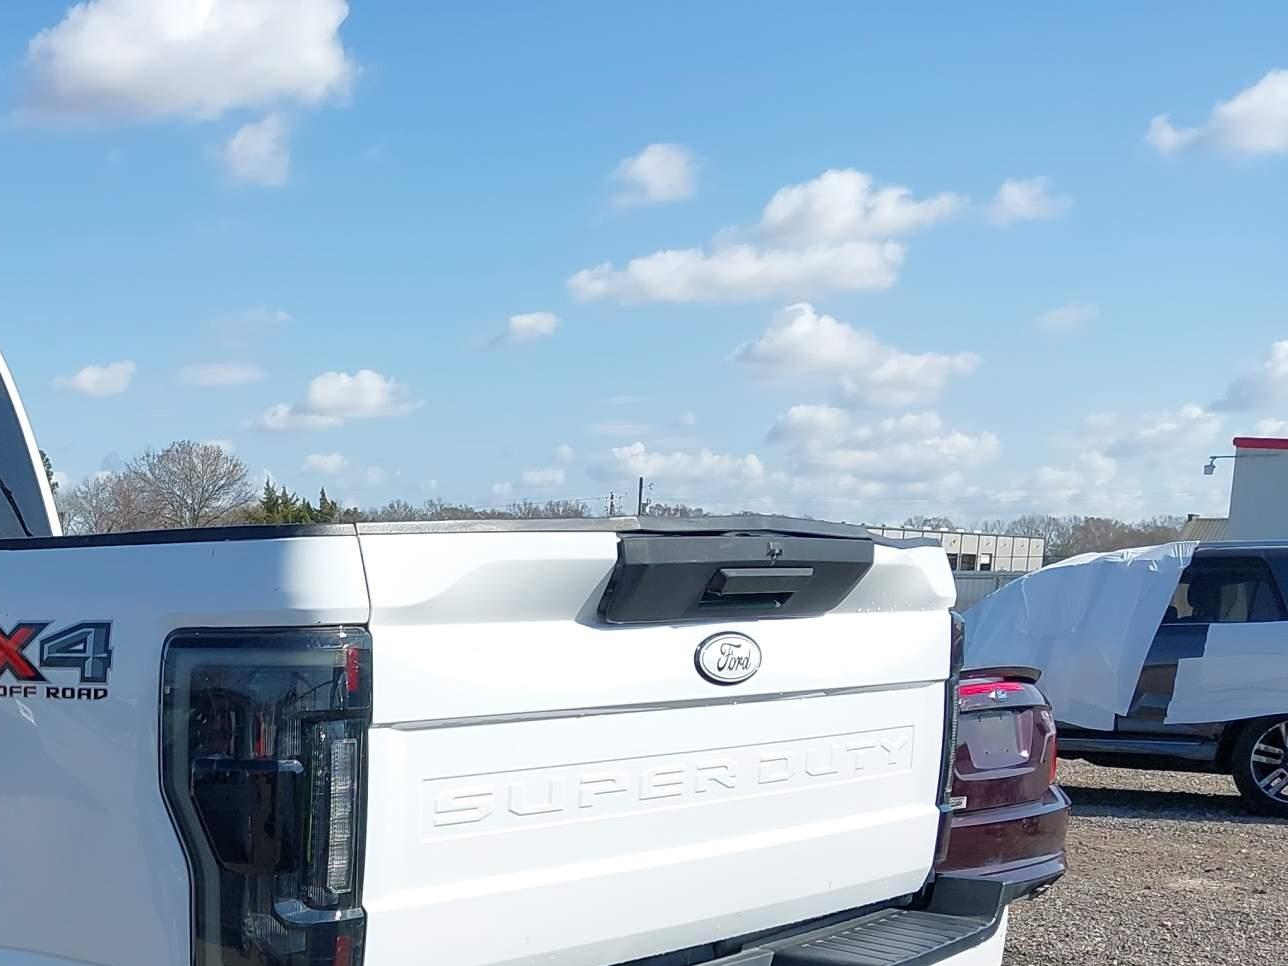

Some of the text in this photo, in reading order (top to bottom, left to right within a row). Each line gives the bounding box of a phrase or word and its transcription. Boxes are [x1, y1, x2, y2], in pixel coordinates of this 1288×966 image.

[716, 642, 752, 672] Ford
[45, 686, 109, 700] ROAD
[433, 734, 909, 827] SUPER DUTY
